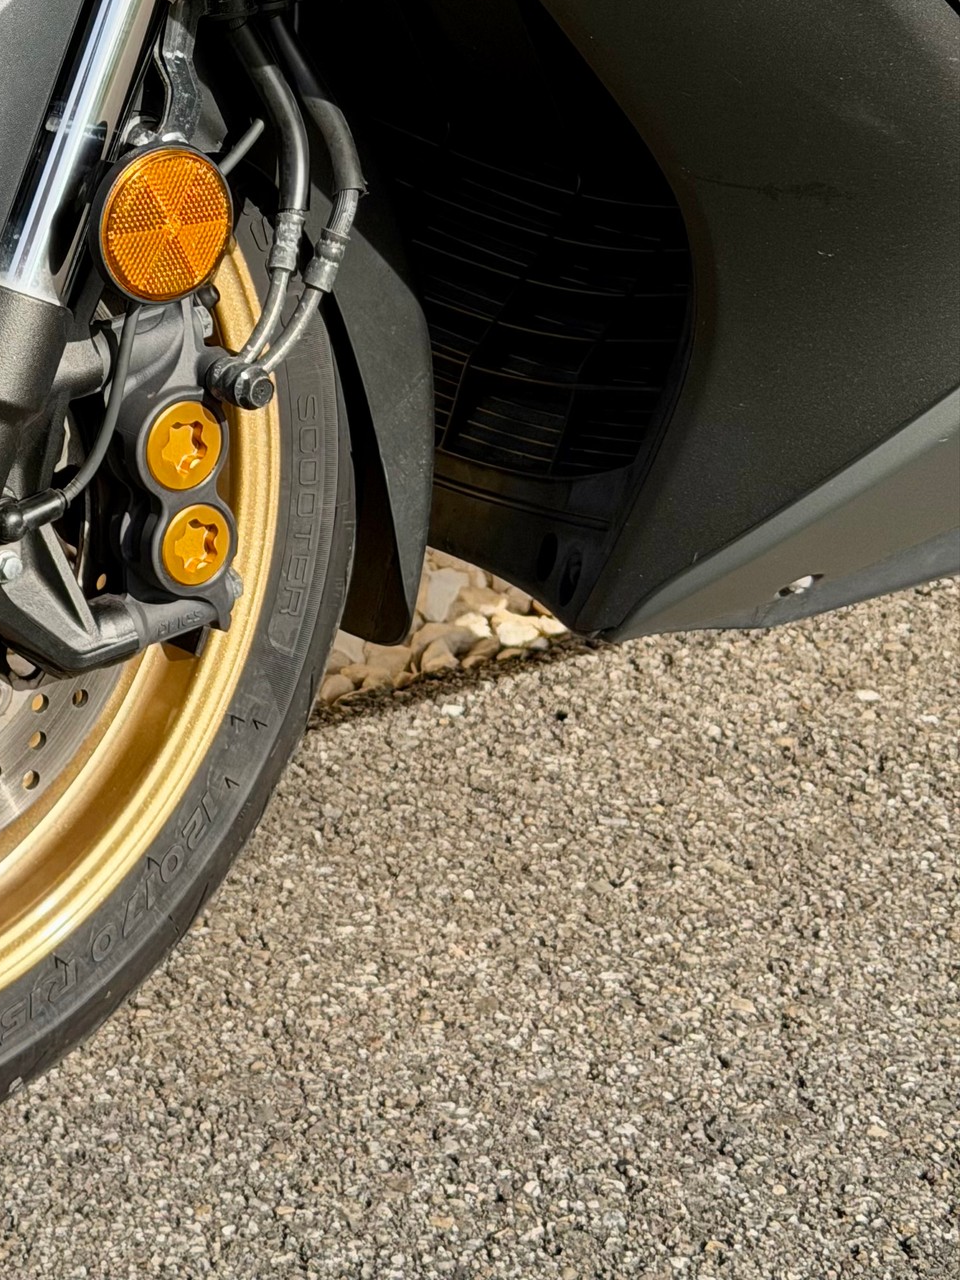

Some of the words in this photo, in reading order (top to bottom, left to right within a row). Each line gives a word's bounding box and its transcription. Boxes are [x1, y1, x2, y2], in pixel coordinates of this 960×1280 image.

[278, 393, 320, 618] SCOOTER
[90, 789, 219, 963] 120/70
[0, 957, 80, 1041] R15
